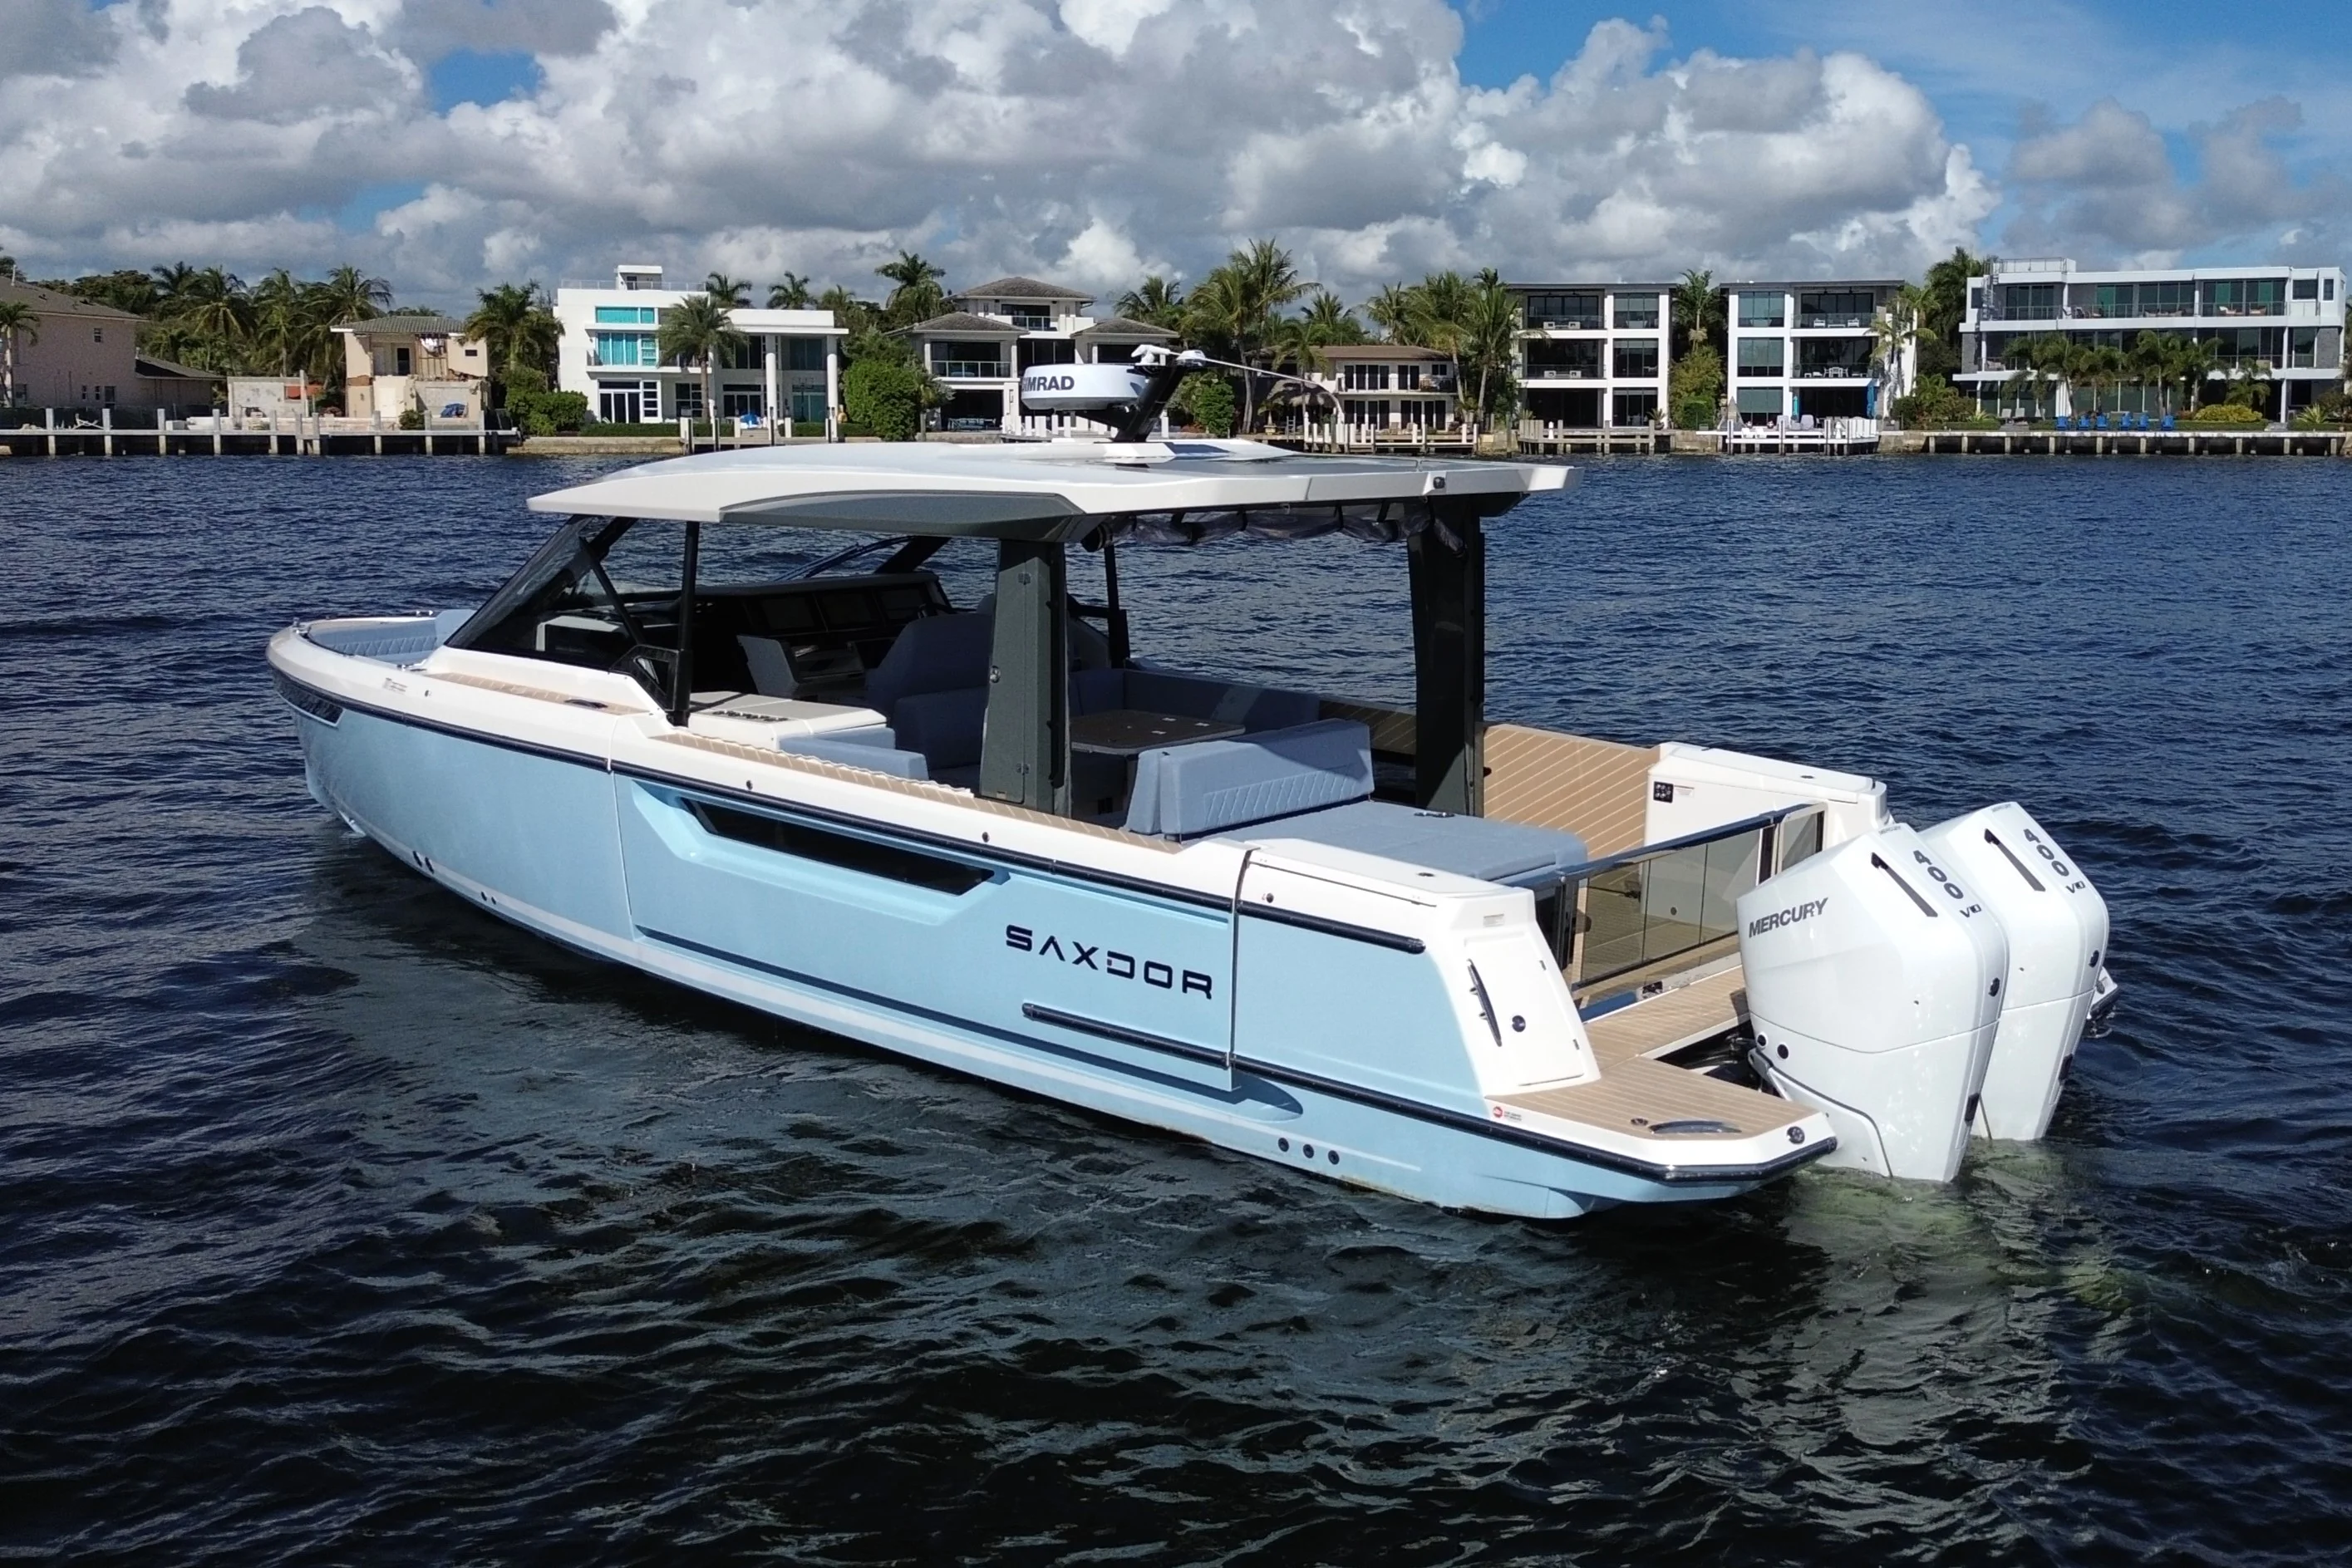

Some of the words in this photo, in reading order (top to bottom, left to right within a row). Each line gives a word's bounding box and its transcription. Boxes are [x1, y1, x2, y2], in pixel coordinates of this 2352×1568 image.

[1913, 850, 1964, 900] 400
[2023, 828, 2069, 877] 400
[1749, 897, 1828, 938] MERCURY
[1006, 924, 1213, 1000] SAXDOR
